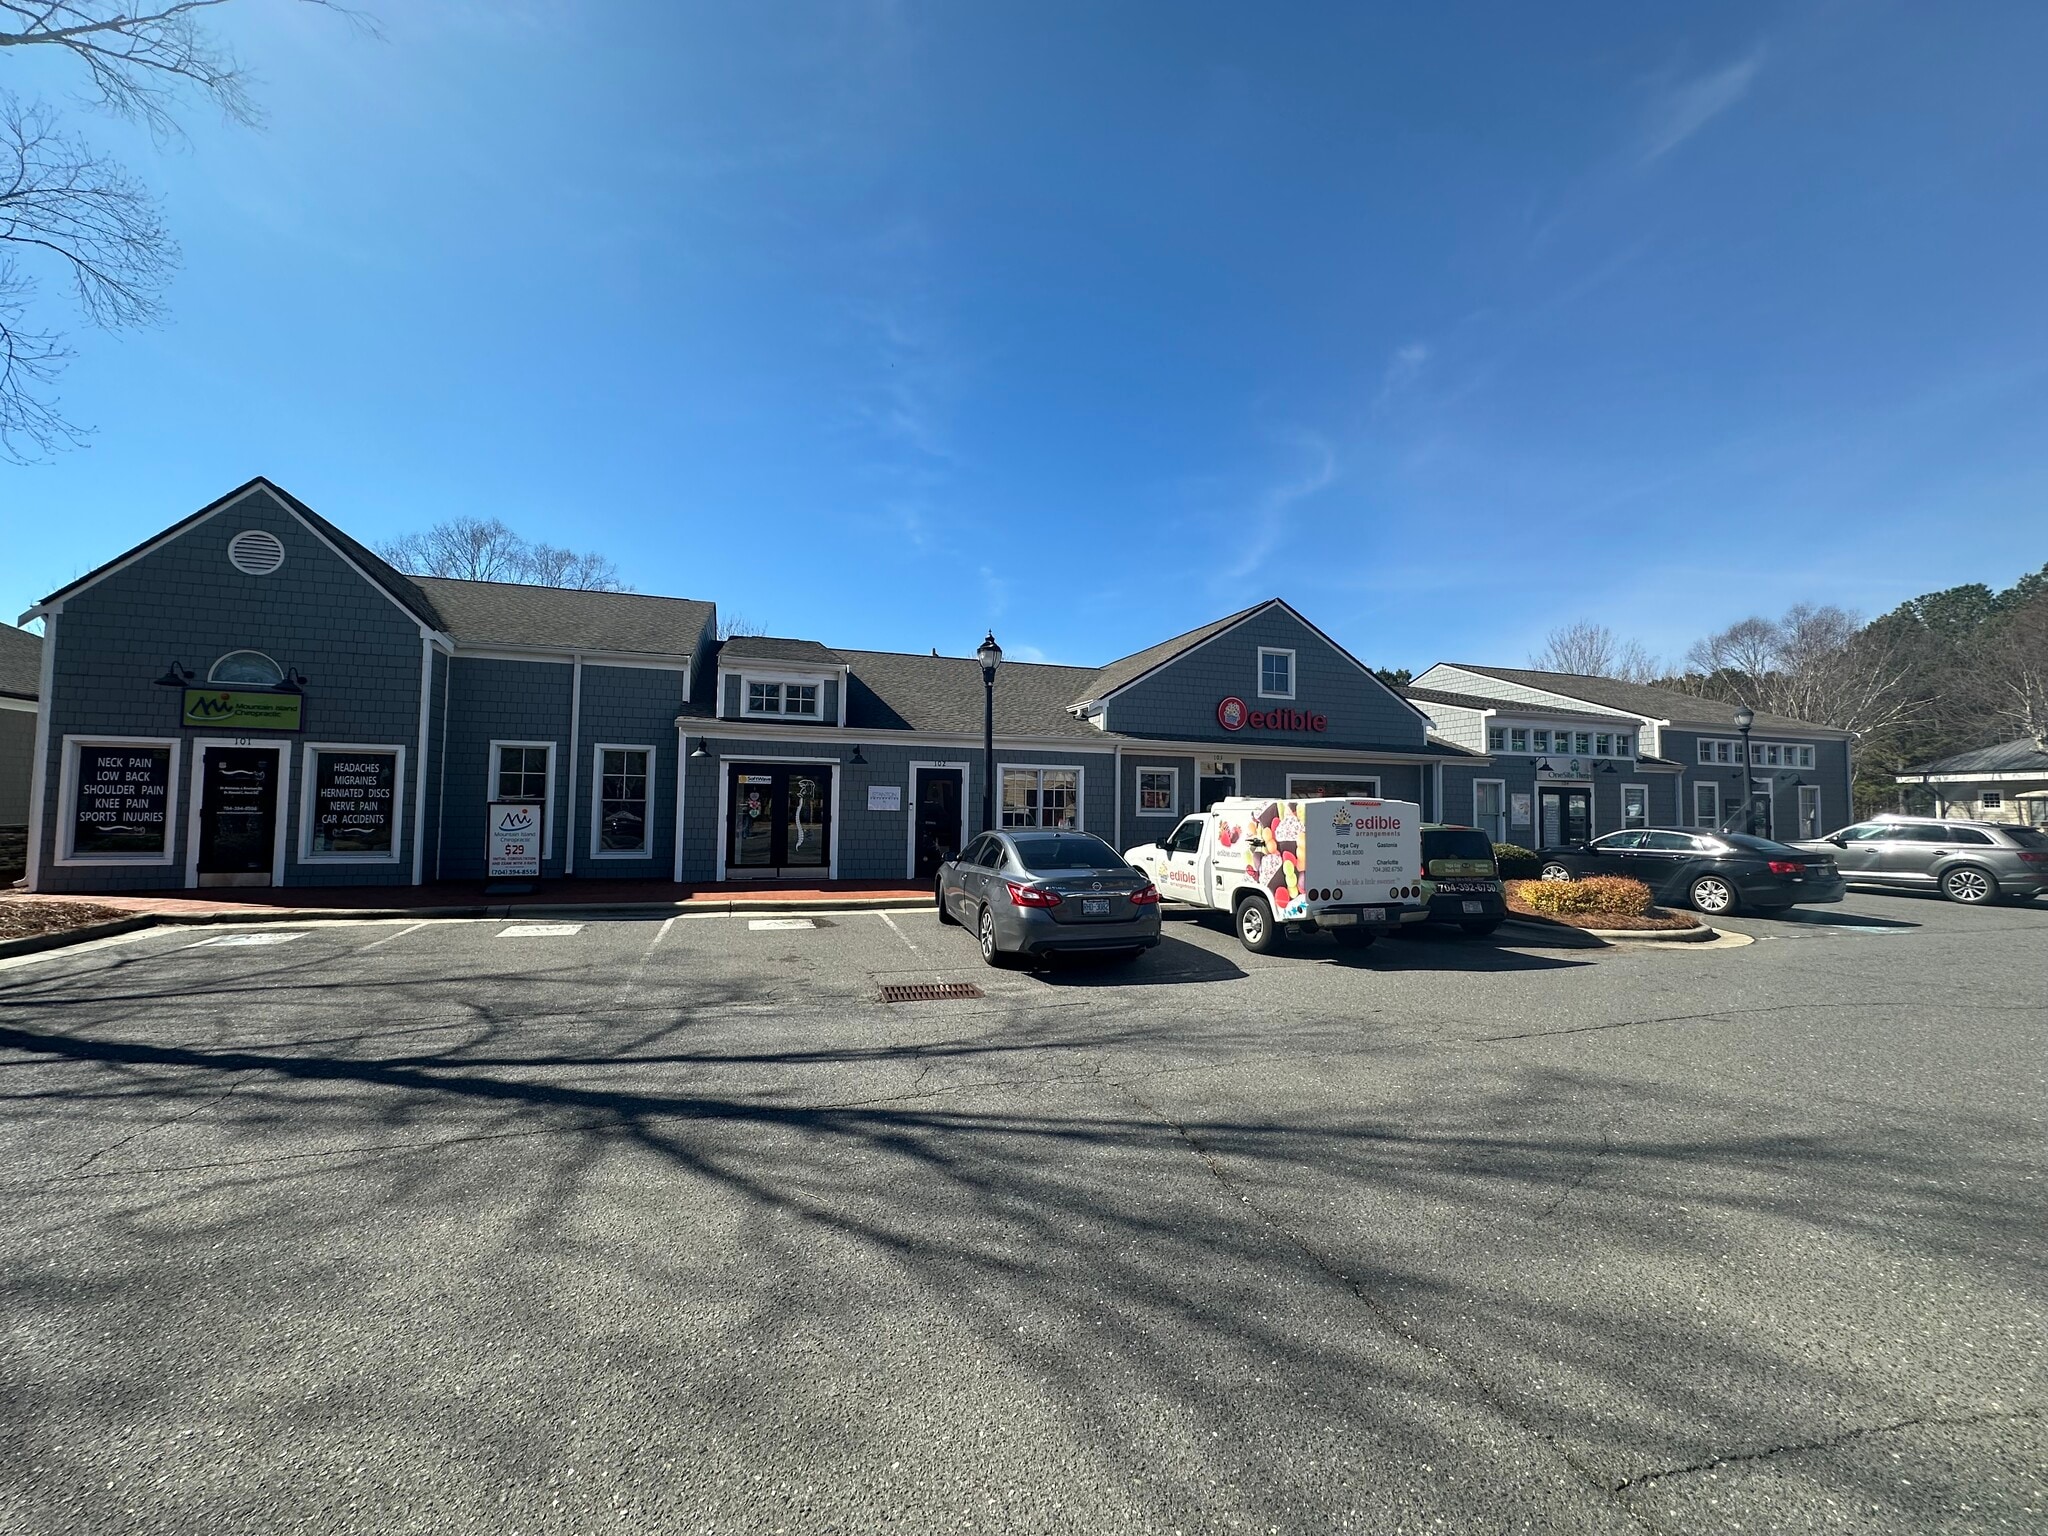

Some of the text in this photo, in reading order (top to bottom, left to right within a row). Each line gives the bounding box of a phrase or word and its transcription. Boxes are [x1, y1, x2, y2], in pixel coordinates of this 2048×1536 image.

[236, 703, 273, 711] Mountain
[234, 709, 282, 718] Chiropractic
[1248, 707, 1328, 732] edible
[234, 738, 252, 746] 101
[97, 757, 152, 768] NECK PAIN
[333, 763, 380, 773] HEADACHES
[96, 771, 151, 782] LOW BACK
[334, 775, 377, 785] MIGRAINES
[83, 784, 164, 795] SHOULDER PAIN
[320, 788, 390, 798] HERNIATED DISCS
[95, 798, 149, 809] KNEE PAIN
[330, 801, 378, 811] NERVE PAIN
[79, 811, 164, 822] SPORTS INJURIES
[321, 814, 385, 824] CAR ACCIDENTS
[1355, 815, 1401, 830] edible
[1355, 830, 1400, 838] arrangements
[504, 843, 525, 856] $29
[1217, 849, 1241, 858] edible.com
[1169, 869, 1196, 885] edible
[1169, 881, 1196, 891] arrangements
[1437, 883, 1496, 893] 704-392-6750
